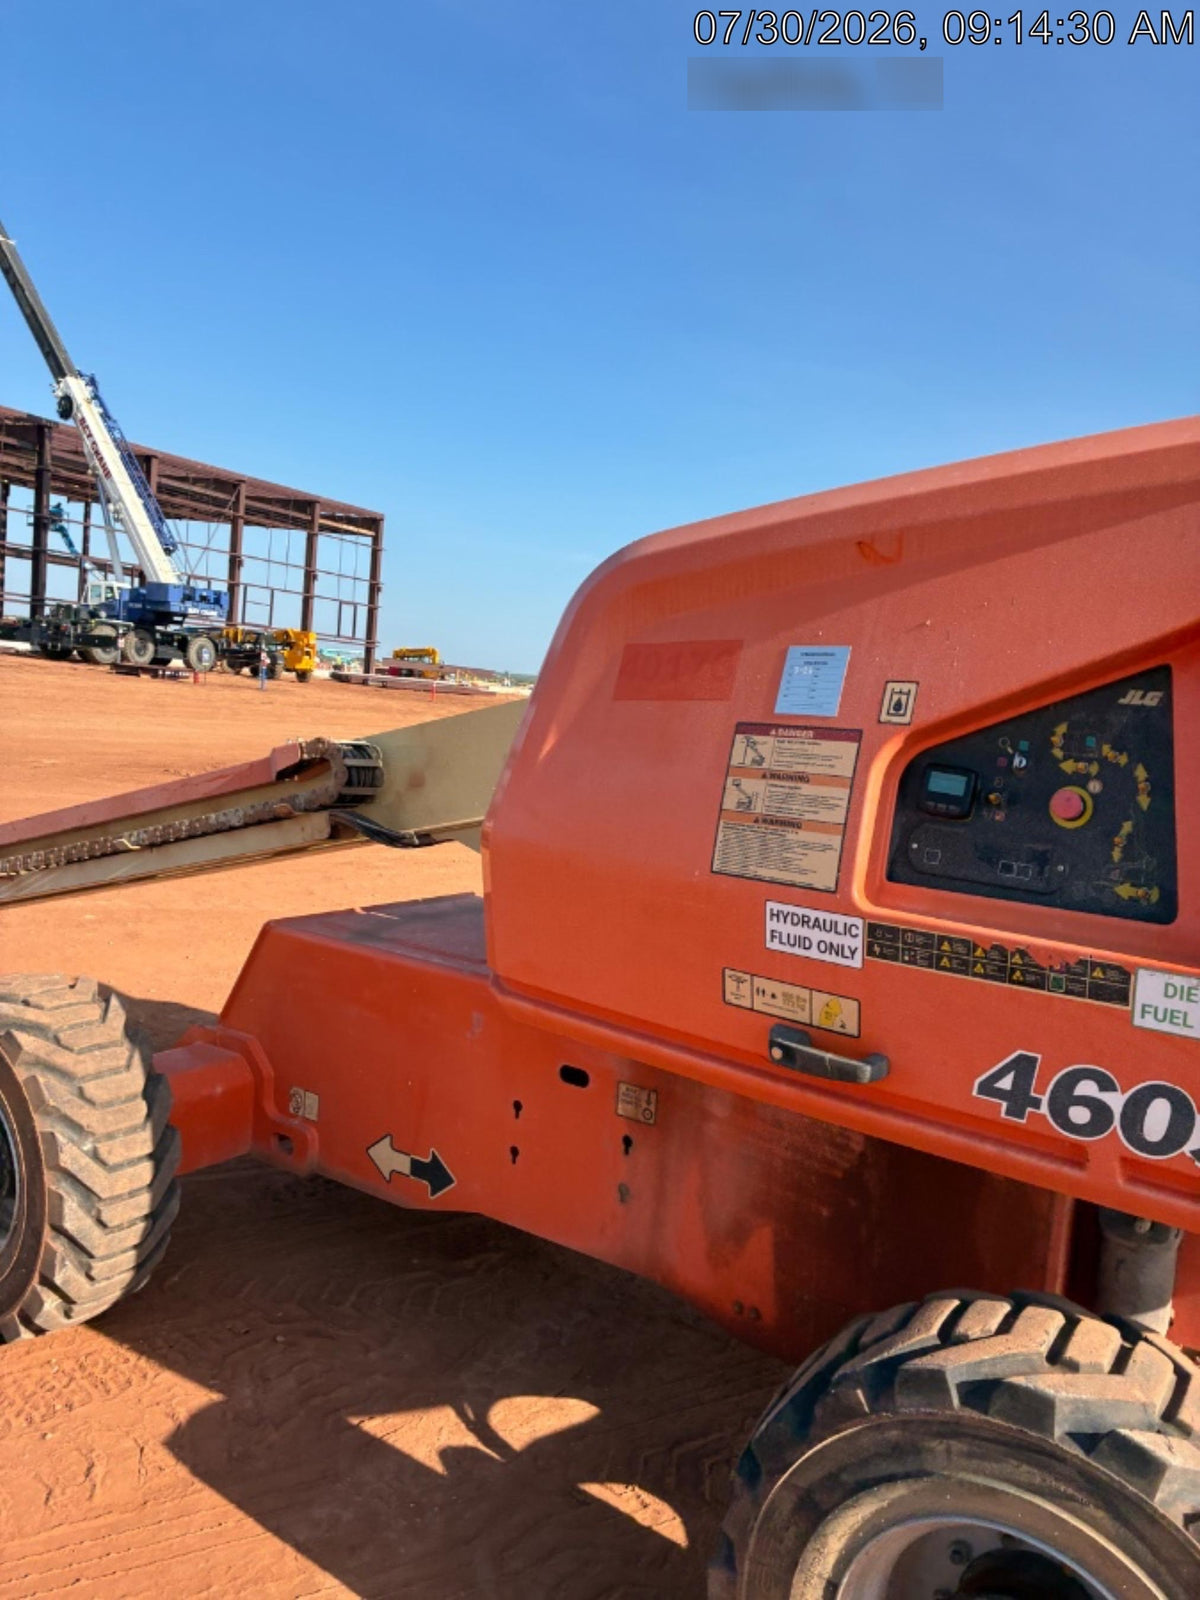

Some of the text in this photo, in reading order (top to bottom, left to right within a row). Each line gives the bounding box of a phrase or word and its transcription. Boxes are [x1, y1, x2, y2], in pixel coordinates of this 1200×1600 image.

[1117, 689, 1164, 706] JLG
[769, 772, 810, 784] WARNING
[761, 816, 802, 829] WARNING
[769, 908, 860, 938] HYDRAULIC
[770, 929, 858, 960] FLUID ONLY
[1141, 1003, 1194, 1029] FUEL
[972, 1049, 1200, 1168] 460
